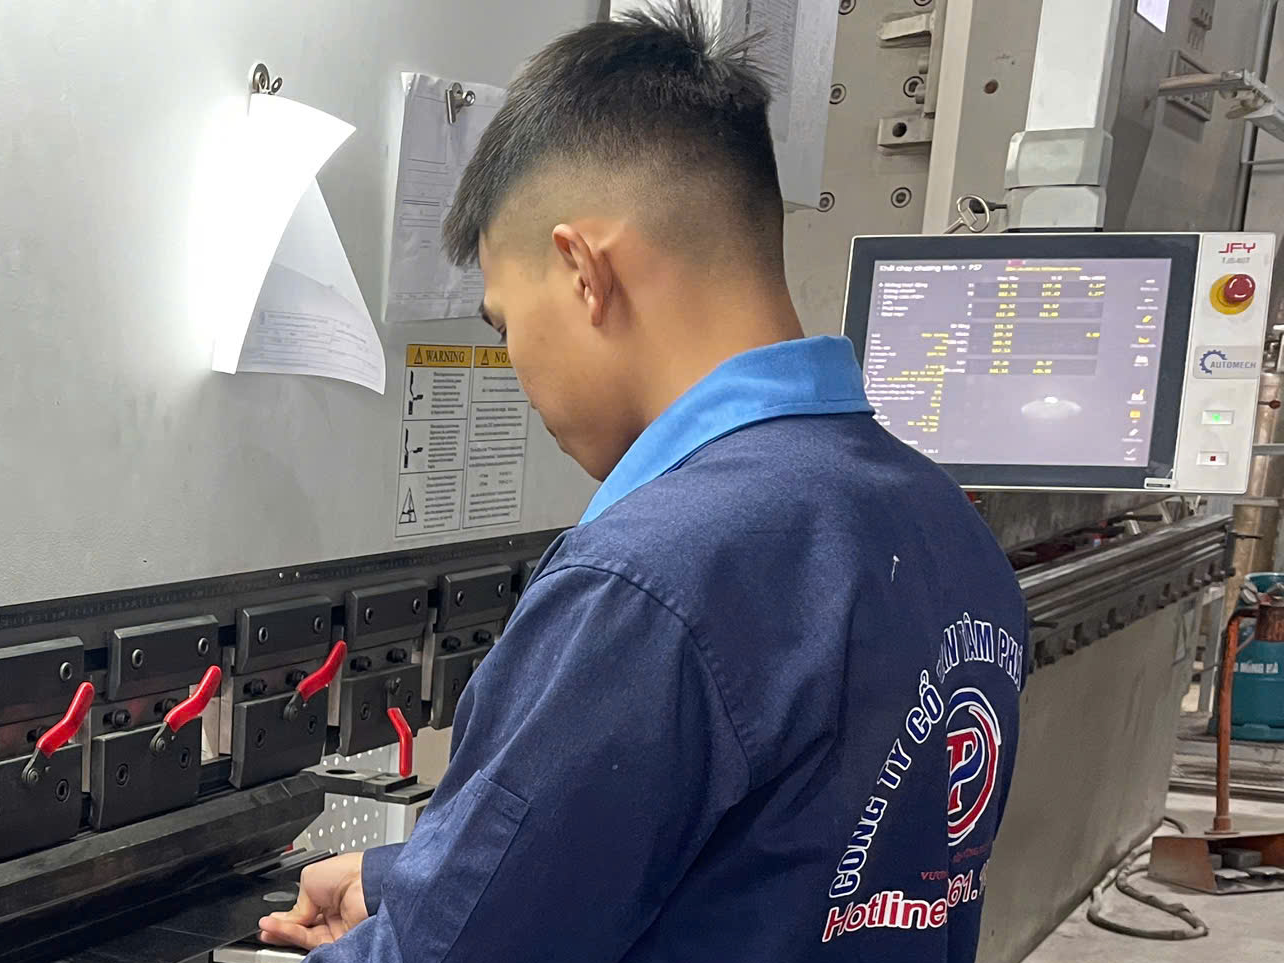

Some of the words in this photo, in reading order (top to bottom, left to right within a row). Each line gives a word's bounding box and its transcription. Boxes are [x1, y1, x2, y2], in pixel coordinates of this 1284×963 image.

[1218, 243, 1256, 253] JFY
[426, 350, 464, 363] WARNING
[495, 351, 511, 363] NO
[1210, 361, 1256, 369] AUTOMECH
[876, 738, 912, 790] TY
[822, 891, 948, 942] Hotline
